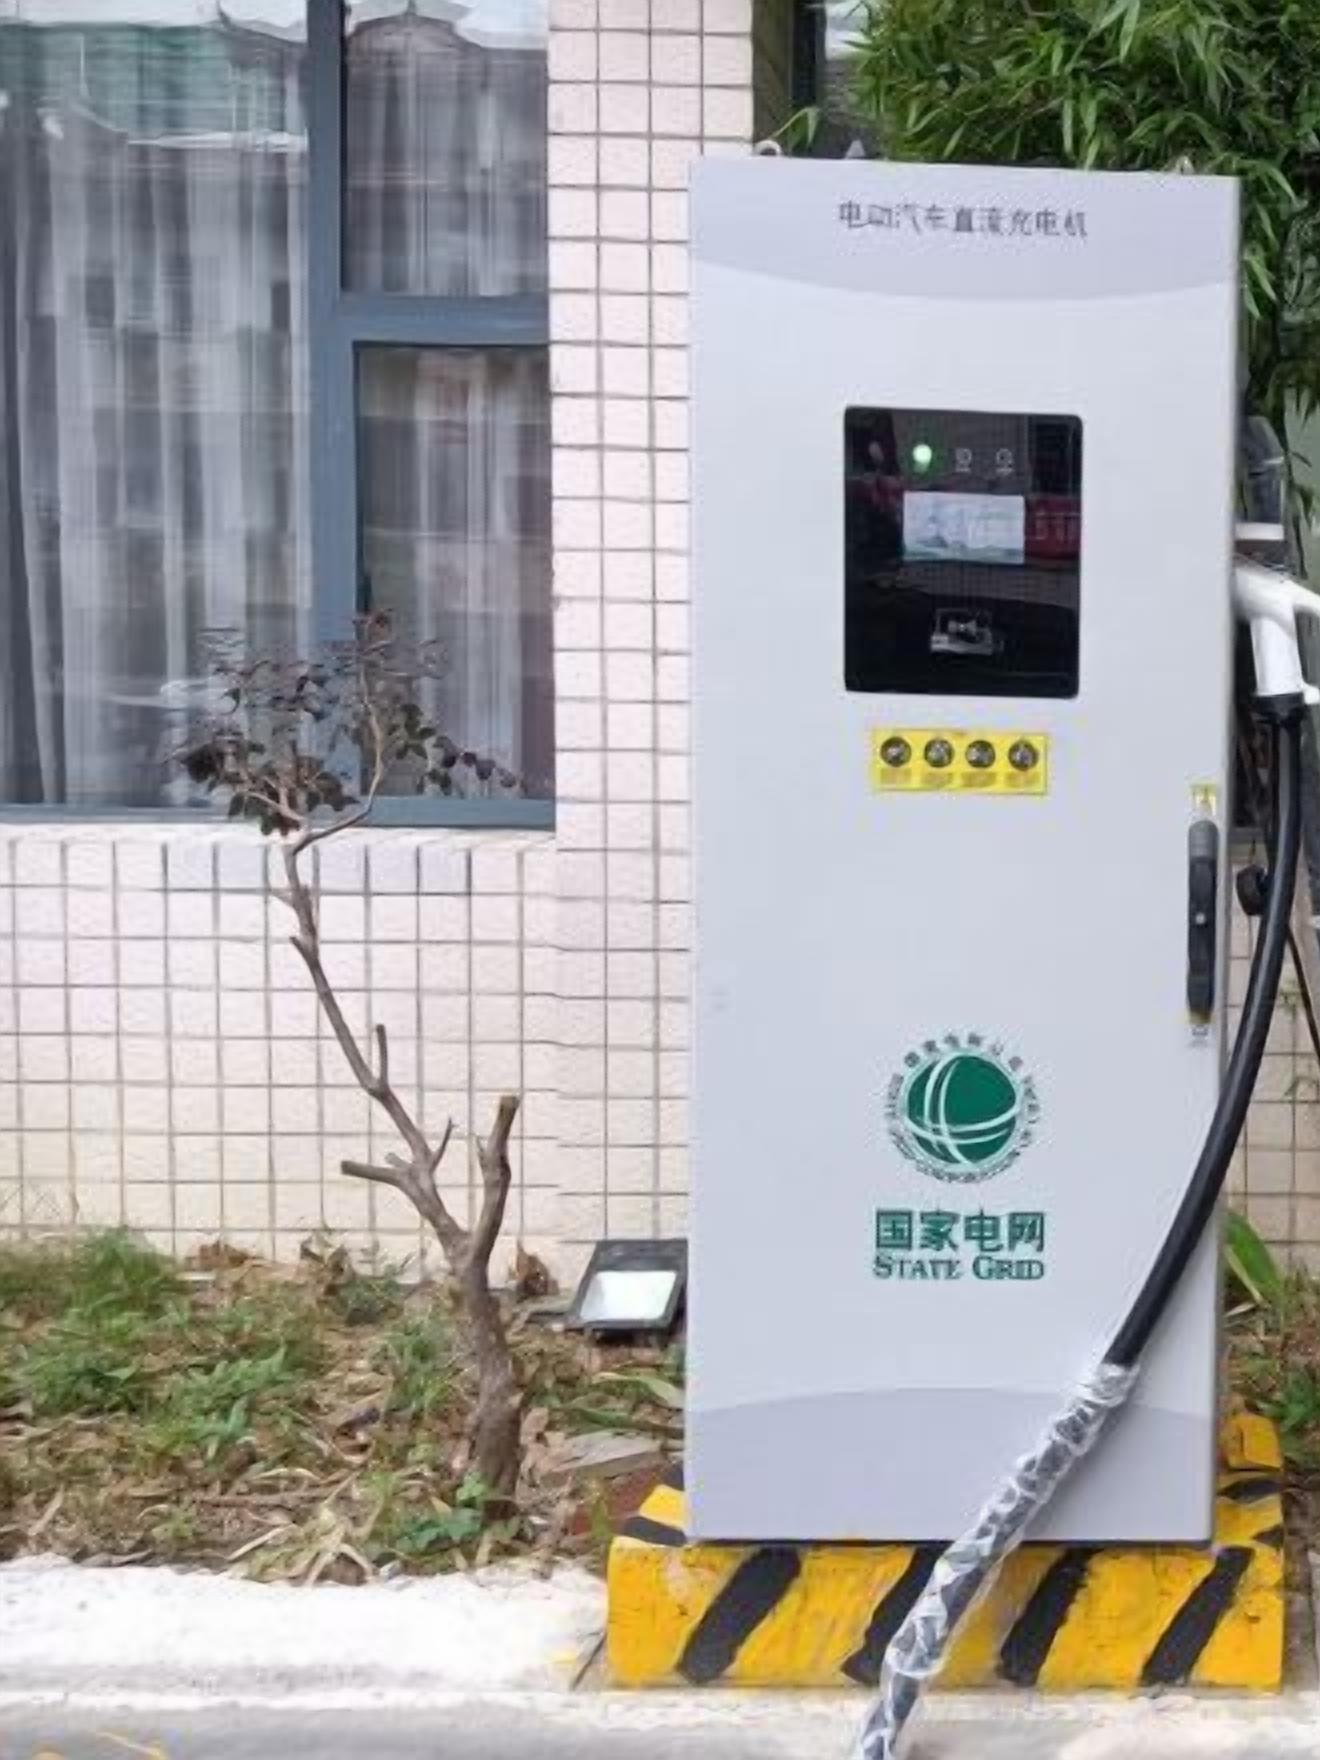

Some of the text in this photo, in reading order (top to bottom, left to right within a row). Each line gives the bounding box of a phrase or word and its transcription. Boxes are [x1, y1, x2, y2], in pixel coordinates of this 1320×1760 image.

[838, 199, 1089, 237] 电动汽车直流充电机
[875, 1206, 1045, 1252] 国家电网
